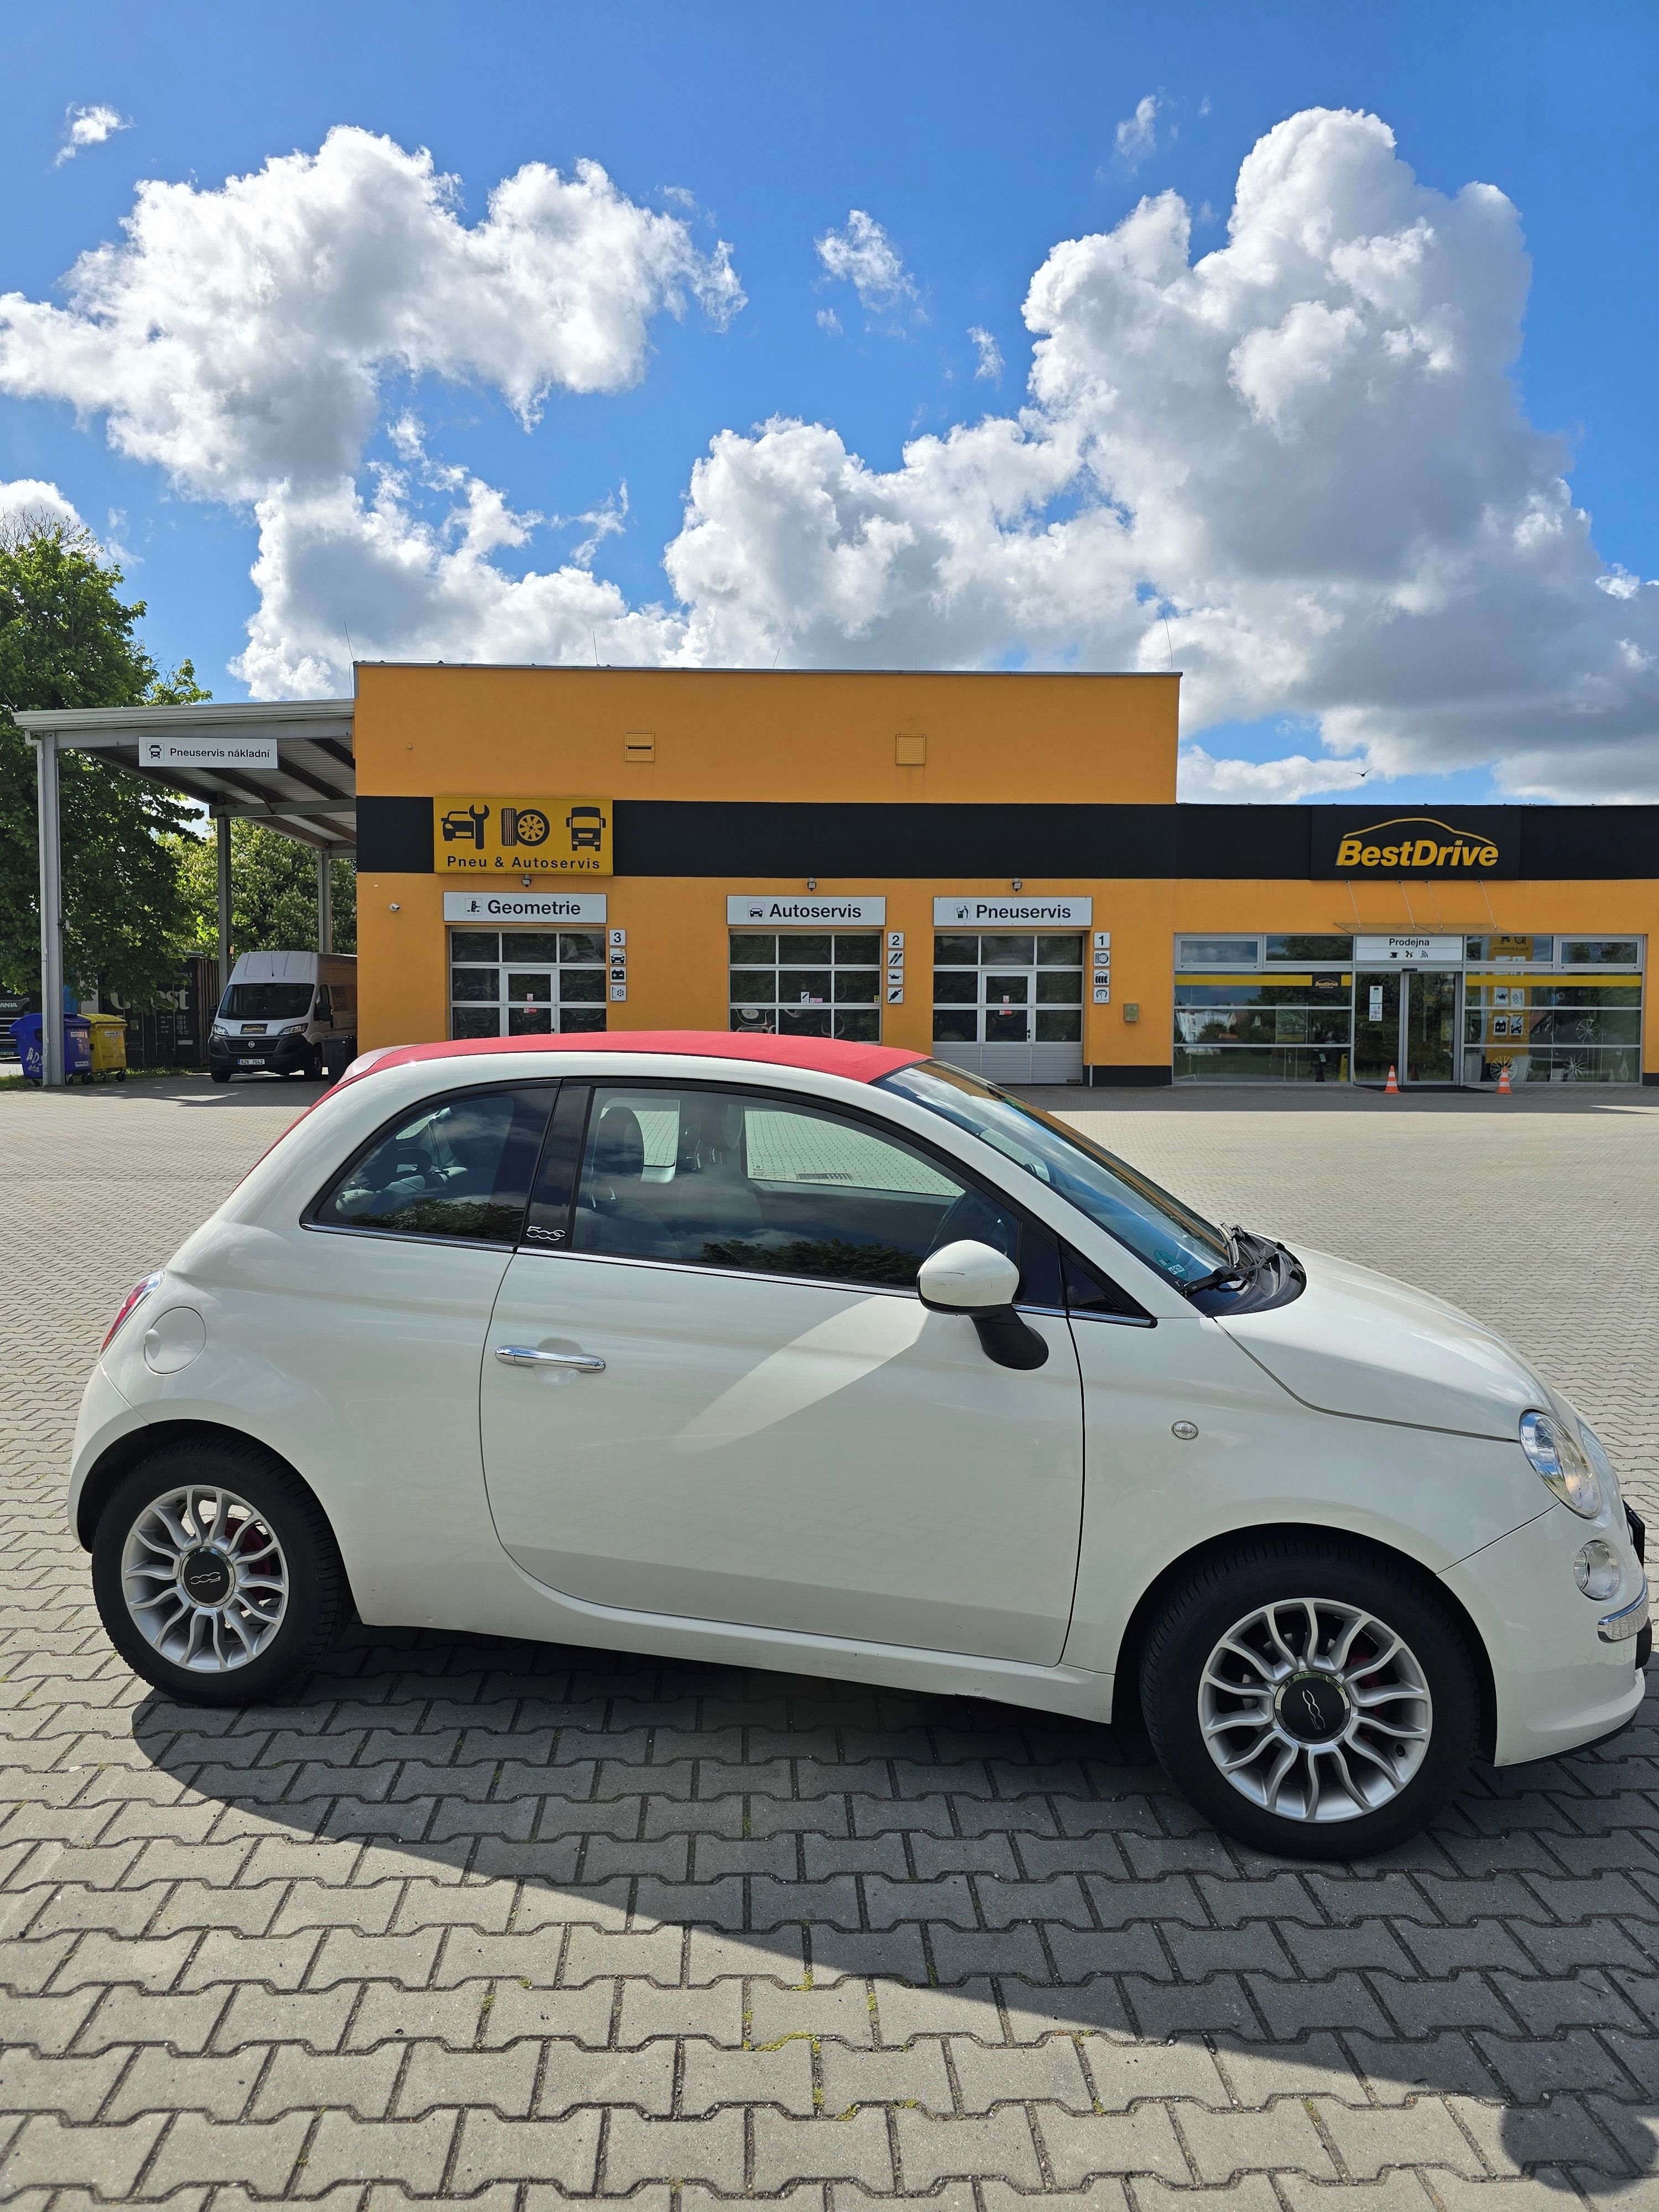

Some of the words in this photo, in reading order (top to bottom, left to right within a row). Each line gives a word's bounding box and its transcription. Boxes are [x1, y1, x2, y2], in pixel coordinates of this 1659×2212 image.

[170, 748, 225, 757] Pneuservis
[228, 749, 270, 758] nákladní
[1335, 840, 1499, 867] BestDrive
[447, 855, 487, 867] Pneu
[495, 857, 504, 868] &
[512, 857, 600, 869] Autoservis
[487, 899, 581, 915] Geometrie
[769, 903, 862, 918] Autoservis
[976, 904, 1071, 919] Pneuservis
[613, 932, 622, 943] 3
[892, 935, 900, 946] 2
[1098, 935, 1104, 946] 1
[1389, 938, 1430, 948] Prodejna
